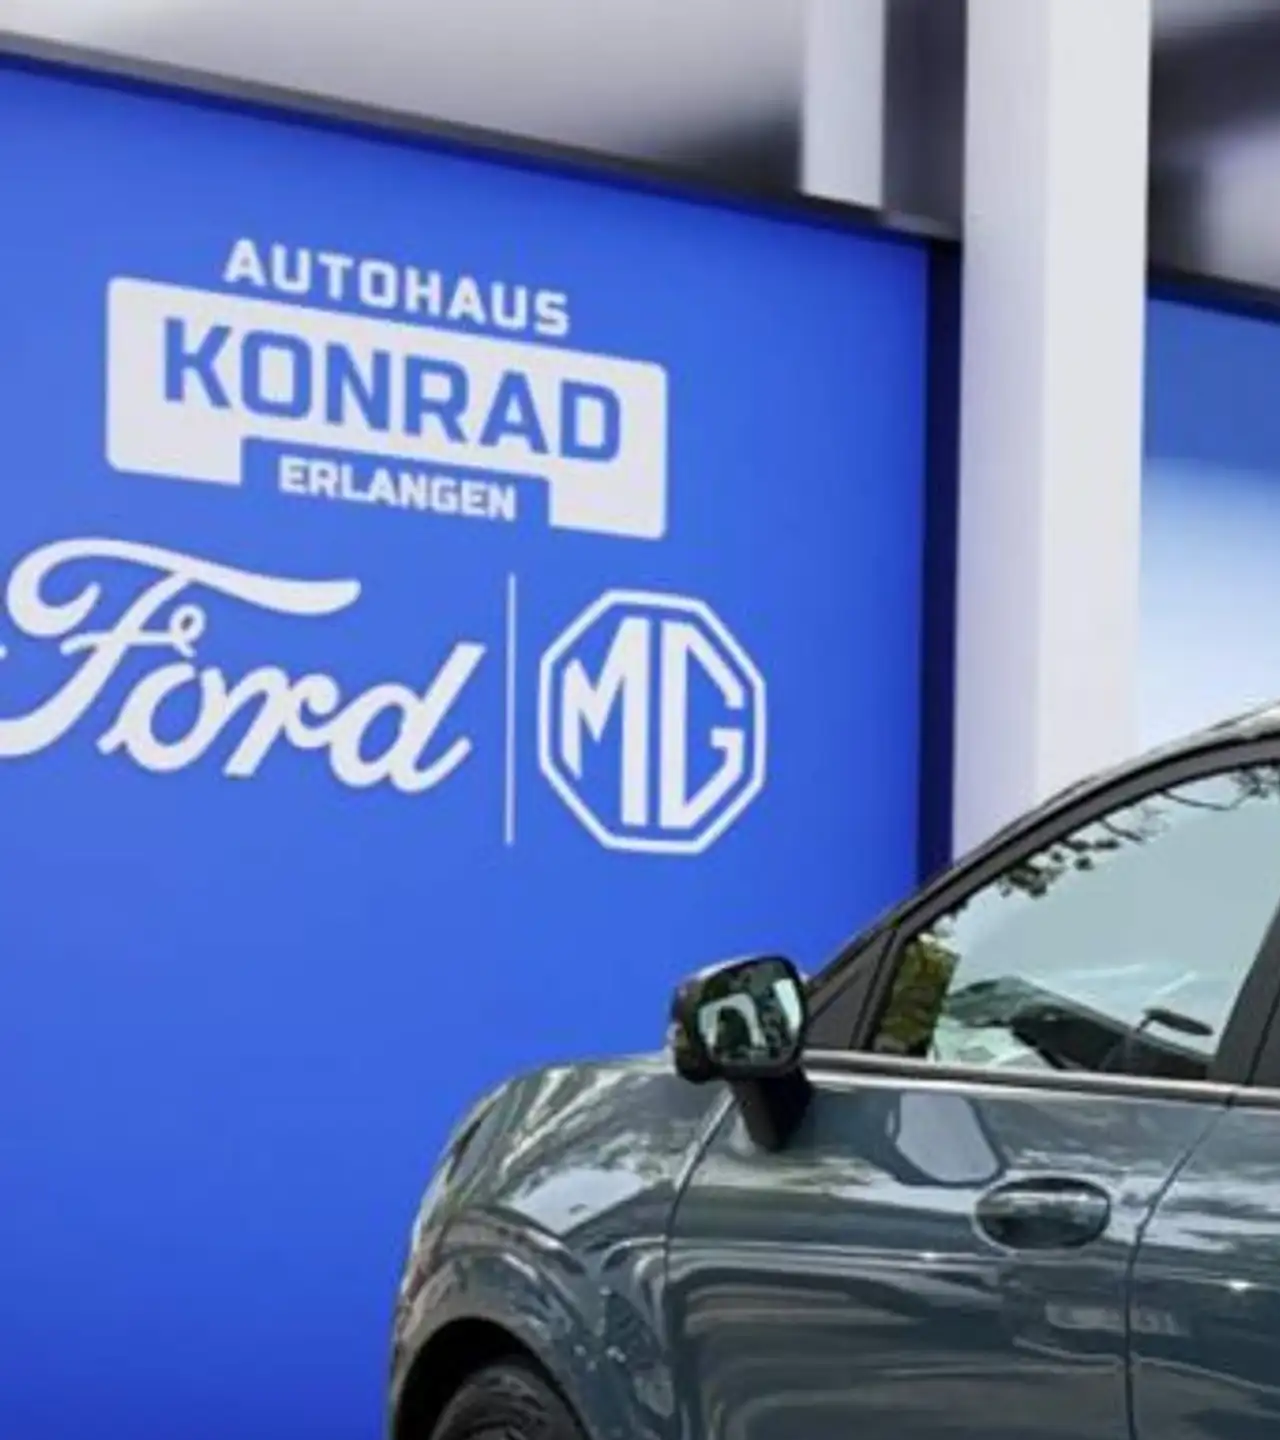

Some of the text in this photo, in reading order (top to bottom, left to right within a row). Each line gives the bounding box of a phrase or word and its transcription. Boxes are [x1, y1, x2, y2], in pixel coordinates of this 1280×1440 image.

[223, 238, 569, 337] AUTOHAUS
[163, 316, 622, 464] KONRAD
[279, 454, 517, 521] ERLANGEN
[0, 537, 486, 793] Ford
[561, 616, 745, 828] MG
